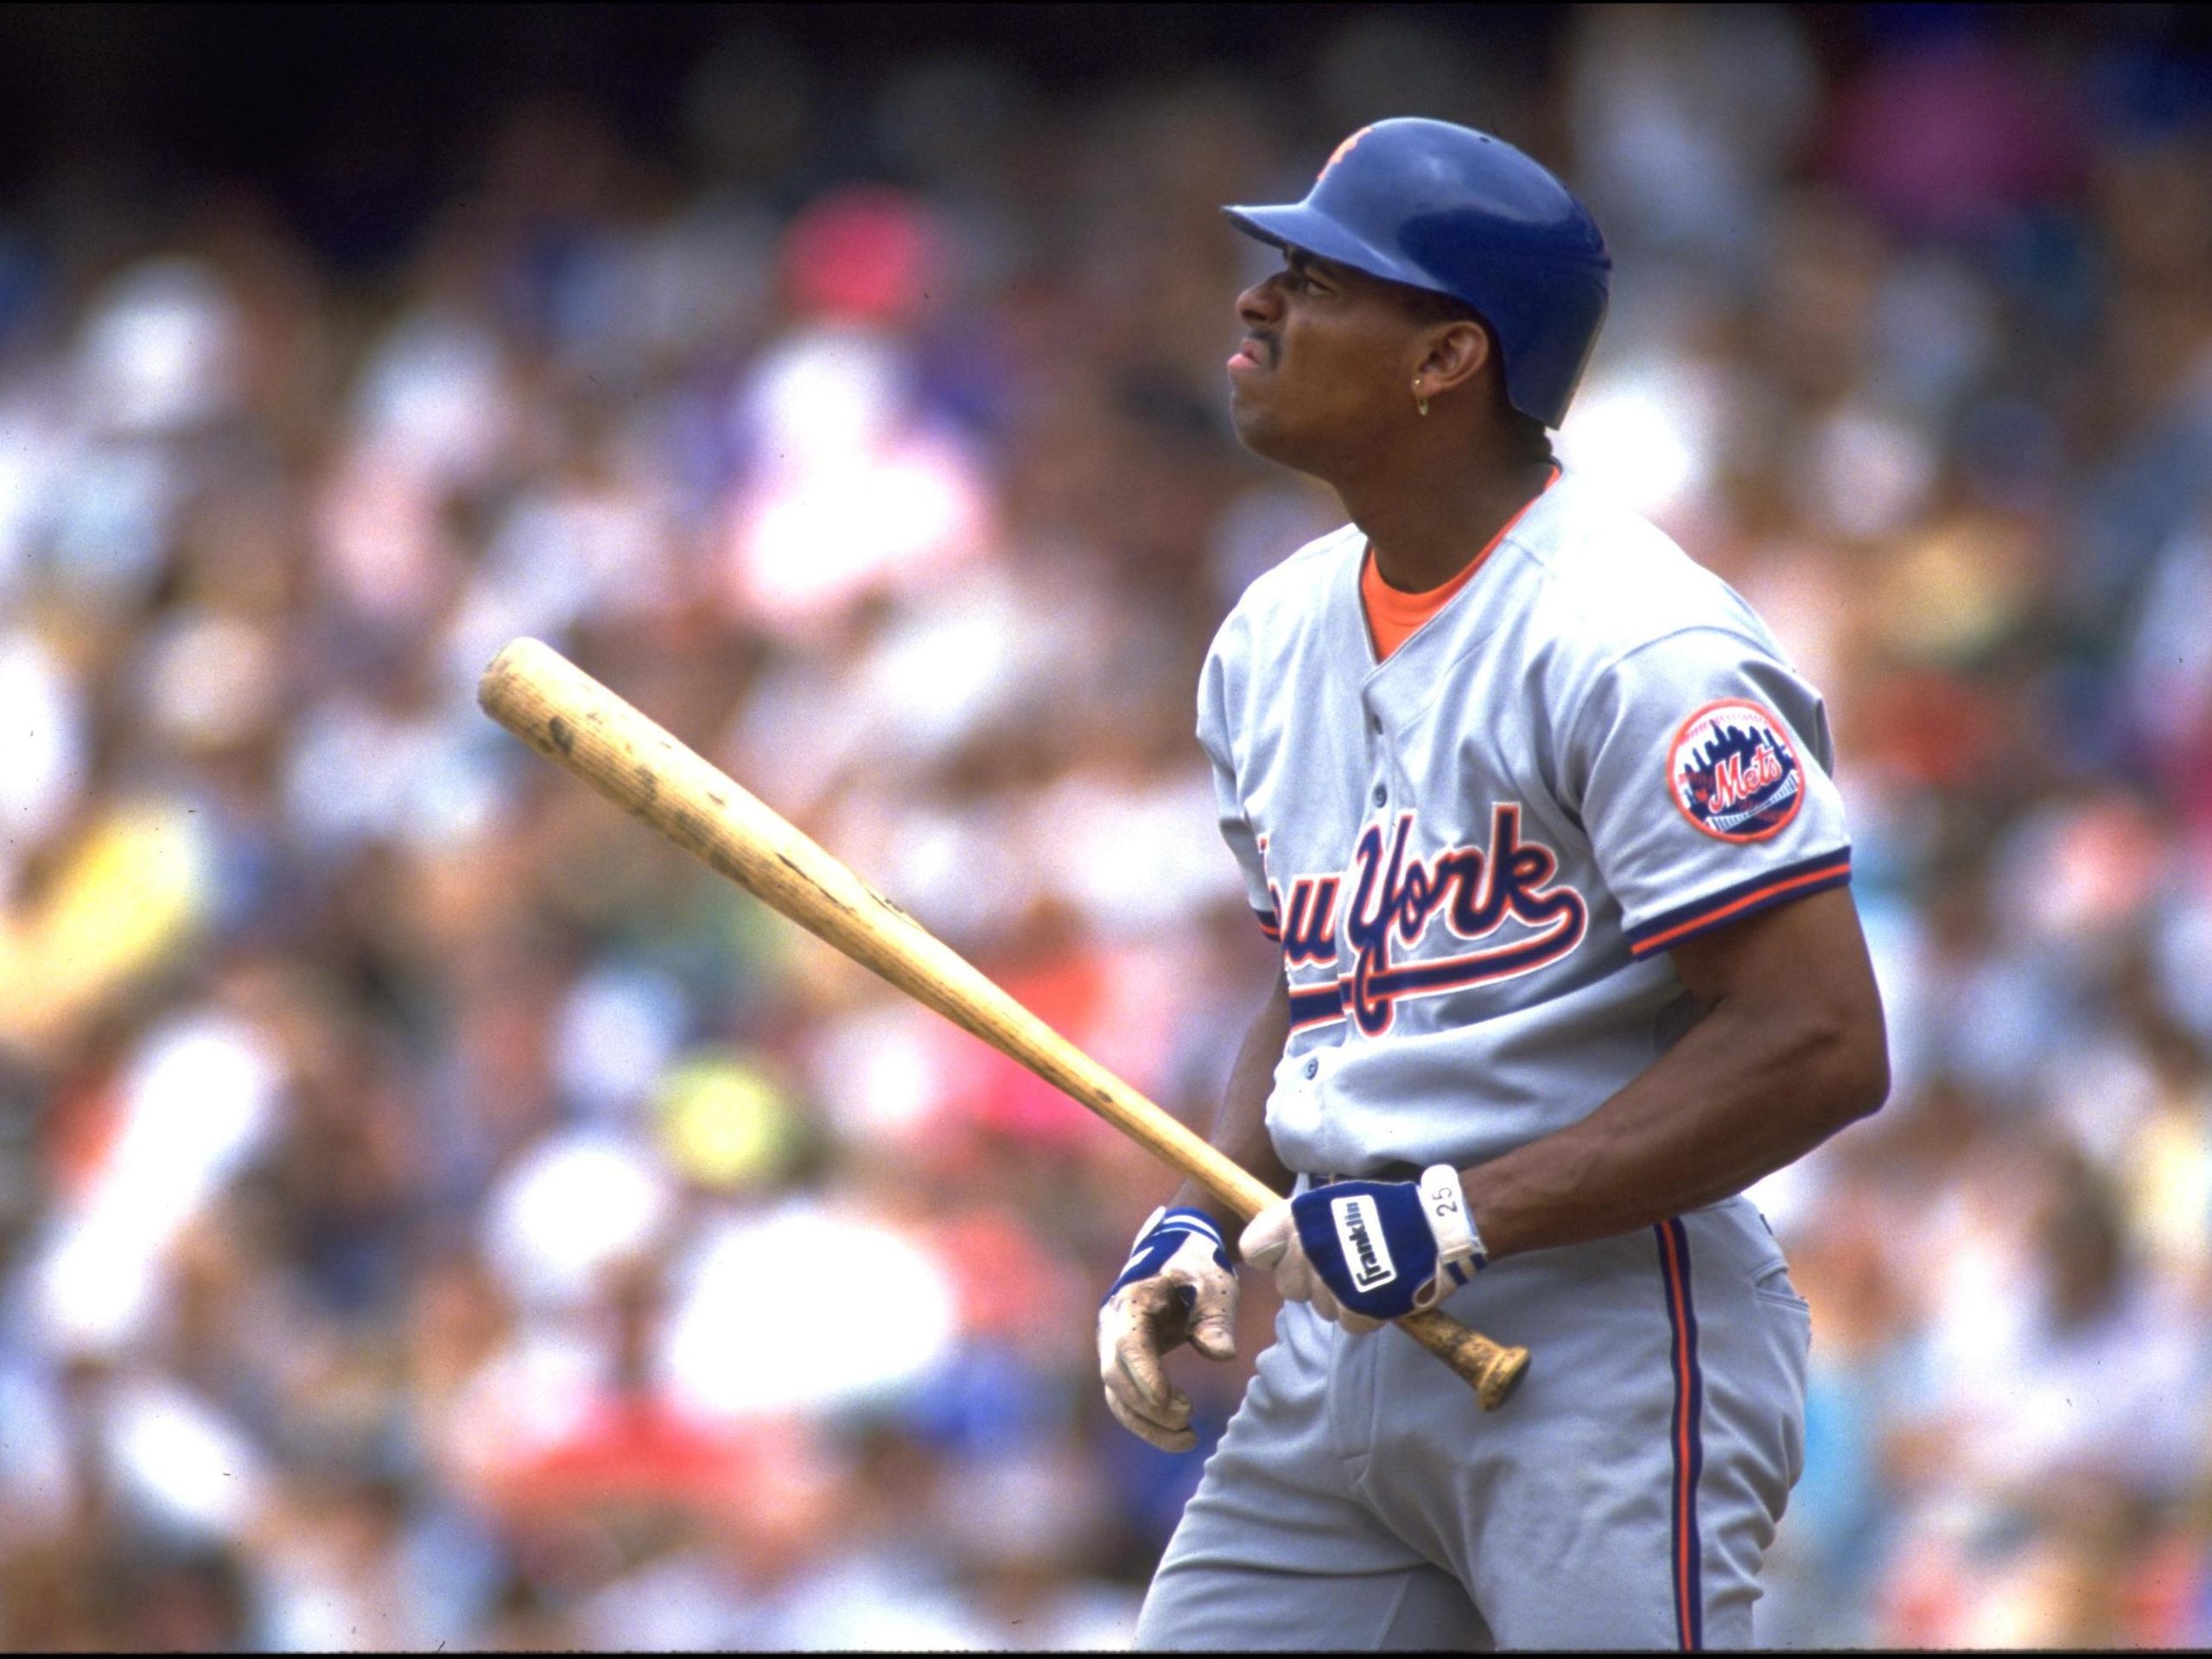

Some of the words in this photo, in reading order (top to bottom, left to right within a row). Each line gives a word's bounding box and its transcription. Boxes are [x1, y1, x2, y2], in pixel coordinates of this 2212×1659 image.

[1708, 742, 1783, 813] Mets
[1347, 802, 1588, 1037] York
[1432, 1187, 1458, 1217] 25
[1344, 1201, 1392, 1287] Franklin
